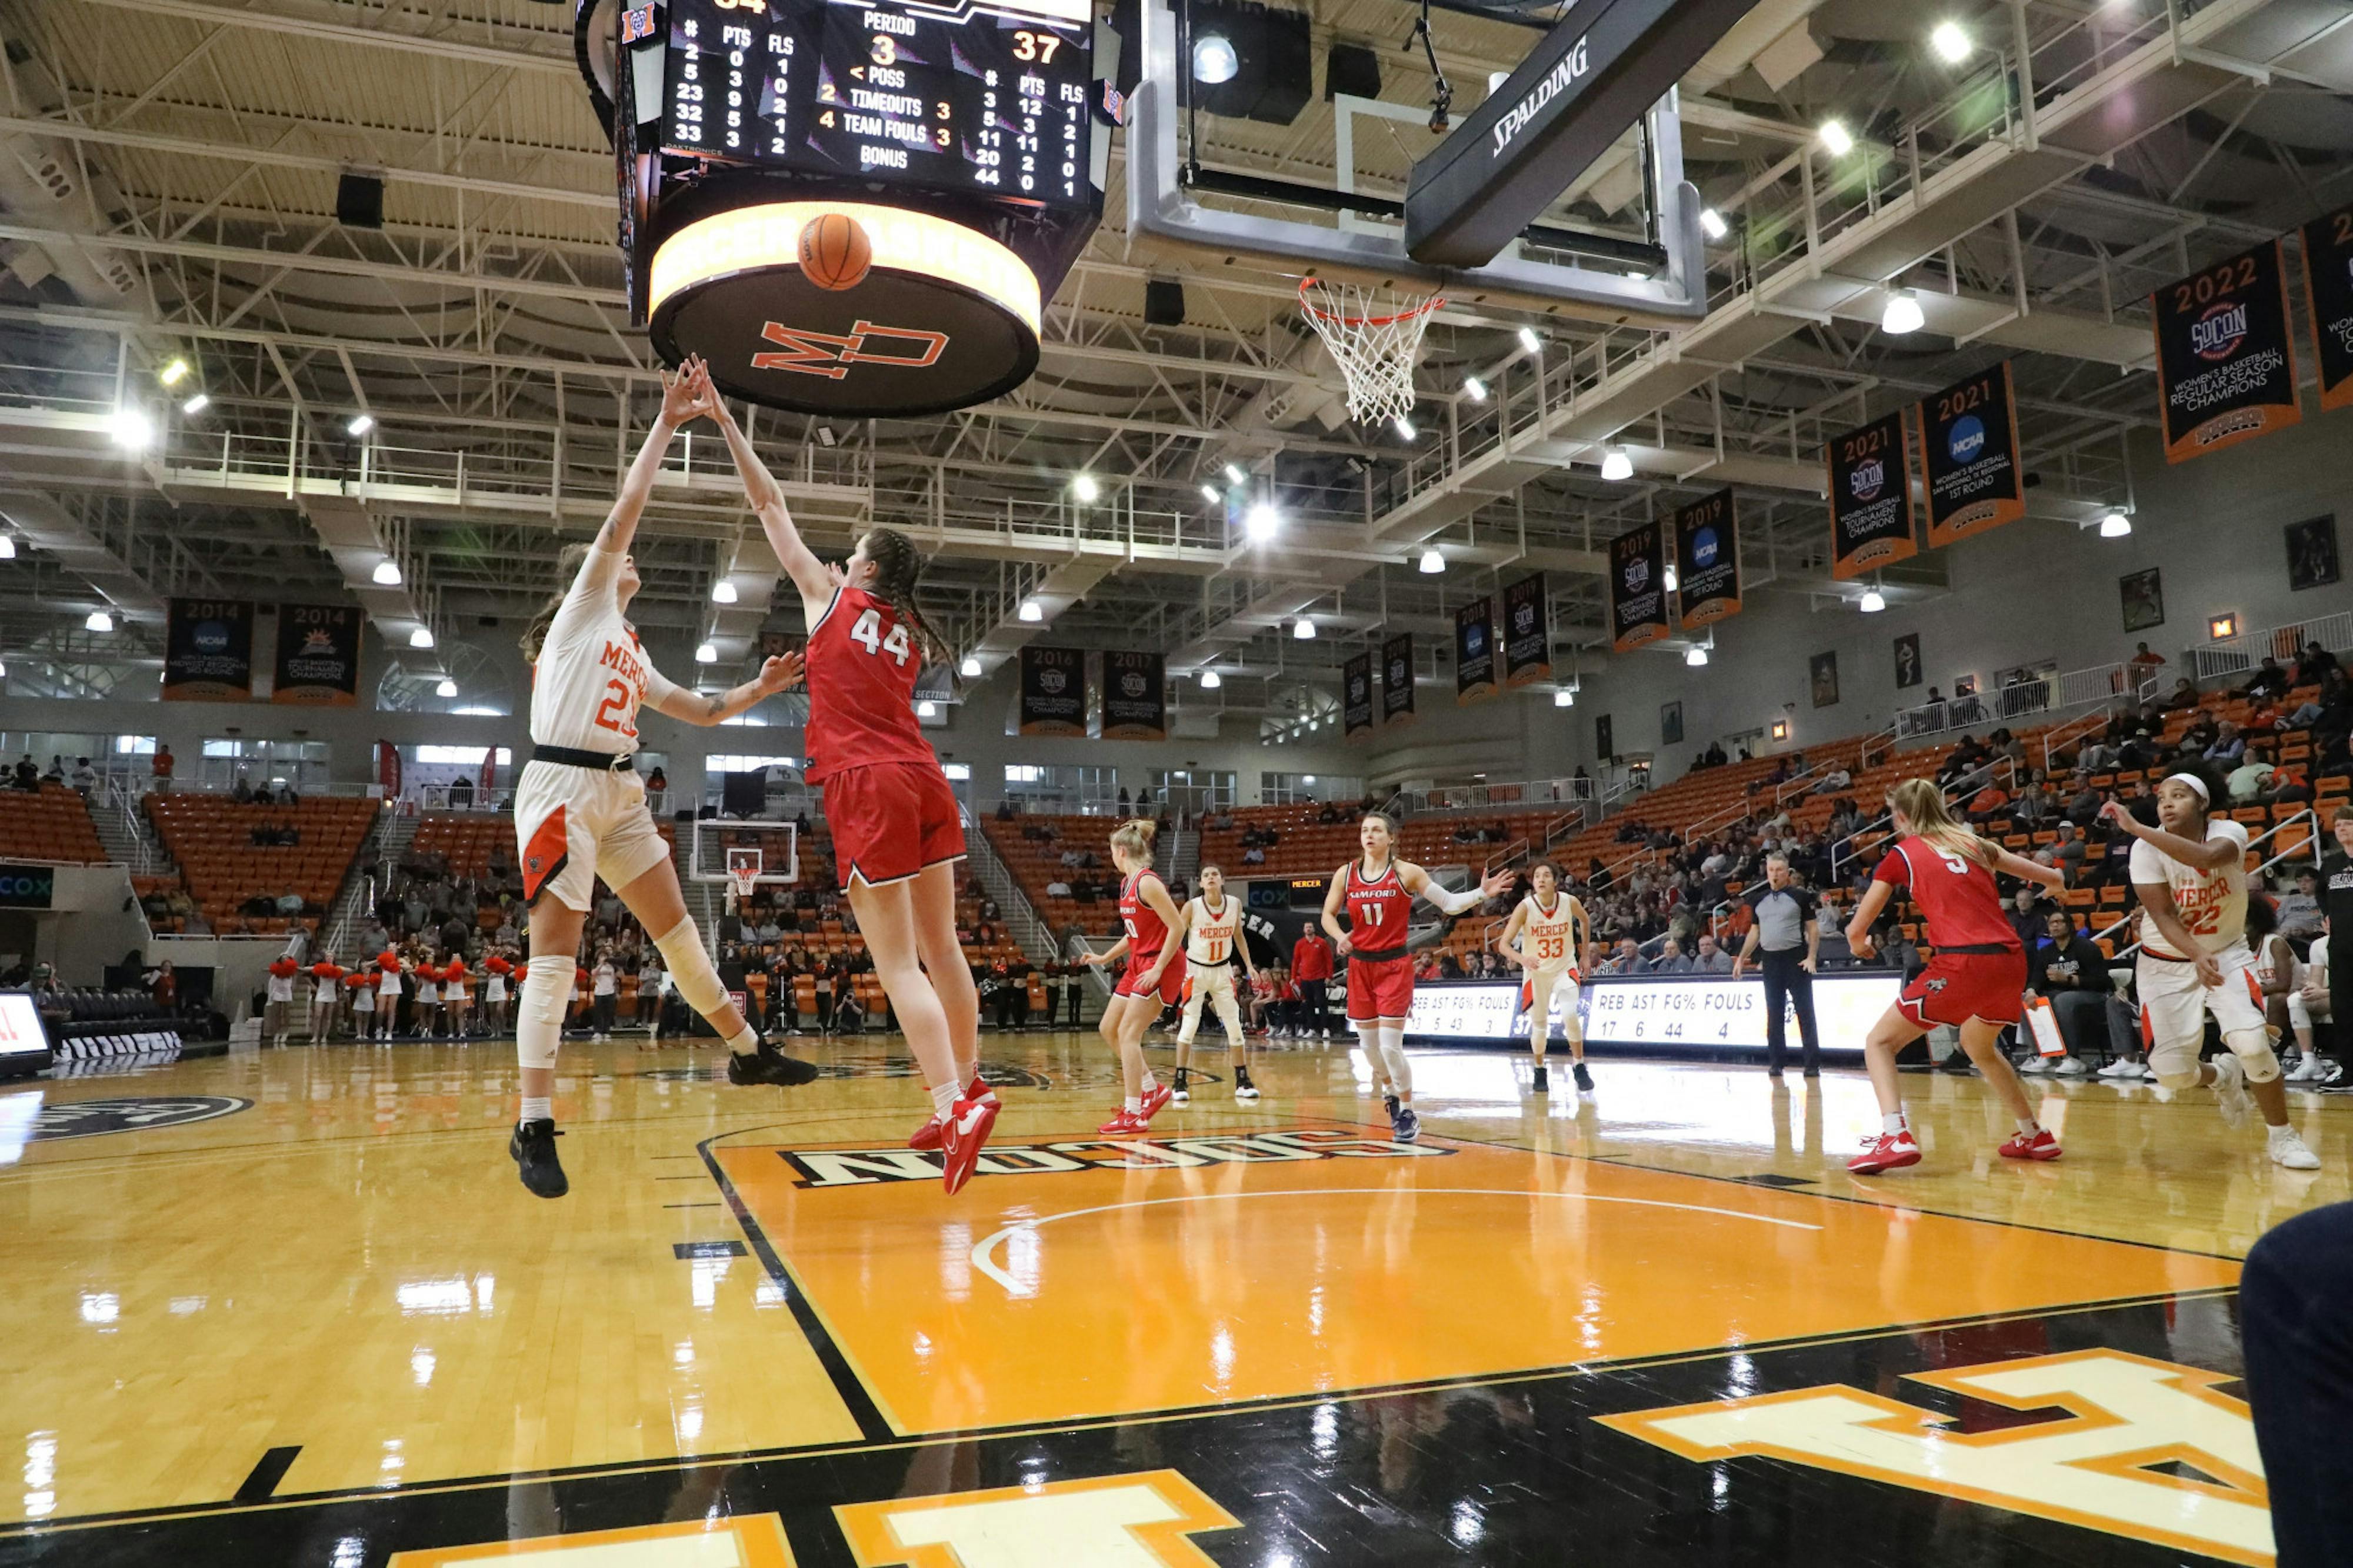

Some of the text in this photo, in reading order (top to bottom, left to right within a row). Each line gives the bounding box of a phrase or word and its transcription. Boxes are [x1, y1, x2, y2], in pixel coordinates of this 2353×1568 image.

[864, 10, 916, 36] PERIOD
[723, 25, 751, 47] PTS
[768, 34, 794, 55] FLS
[871, 34, 896, 66] 3
[1012, 31, 1059, 64] 37
[685, 44, 788, 74] 2 0 1
[684, 63, 788, 94] 5 3 0
[868, 65, 906, 89] POSS
[1019, 75, 1045, 96] PTS
[1061, 83, 1083, 104] FLS
[676, 83, 787, 115] 23 9 2
[821, 84, 951, 120] 2 TIMEOUTS 3
[984, 92, 1076, 121] 3 12 1
[1493, 35, 1590, 159] SPALDING
[676, 102, 786, 134] 32 5 1
[819, 111, 951, 146] 4 TEAM FOULS 3
[983, 111, 1076, 141] 5 3 2
[675, 123, 785, 155] 33 3 2
[979, 129, 1075, 159] 11 11 1
[860, 145, 908, 169] BONUS
[976, 148, 1075, 178] 20 2 0
[975, 168, 1074, 196] 44 0 1
[2177, 258, 2258, 313] 2022
[2170, 354, 2283, 406] REGULAR SEASON
[2175, 368, 2220, 392] WOMEN'S
[2221, 347, 2278, 376] BASKETBALL
[1938, 379, 1990, 422] 2021
[2187, 373, 2268, 412] CHAMPIONS
[1845, 426, 1889, 462] 2021
[1953, 432, 1984, 456] NCAA
[1968, 453, 2005, 473] BASKETBALL
[1949, 475, 1994, 499] 1ST ROUND
[1686, 500, 1721, 531] 2019
[1846, 504, 1897, 529] TOURNAMENT
[1849, 516, 1895, 538] CHAMPIONS
[1620, 531, 1651, 559] 2019
[186, 603, 238, 619] 2014
[294, 608, 345, 625] 2014
[850, 608, 910, 667] 44
[1034, 650, 1073, 666] 2016
[915, 690, 951, 699] SECTION
[0, 876, 51, 895] COX
[1250, 890, 1288, 905] COX
[1292, 880, 1321, 888] MERCER
[1349, 889, 1397, 899] SAMFORD
[1361, 902, 1383, 926] 11
[1199, 926, 1234, 939] MERCER
[1531, 922, 1569, 937] MERCER
[1209, 941, 1223, 961] 11
[1538, 937, 1564, 959] 33
[1432, 997, 1449, 1009] AST
[1453, 997, 1473, 1009] FG%
[1479, 996, 1509, 1009] FOULS
[1599, 995, 1624, 1010] REB
[1632, 994, 1657, 1010] AST
[1664, 994, 1695, 1010] FG%
[1704, 993, 1752, 1010] FOULS
[1434, 1017, 1441, 1030] 5
[1450, 1018, 1462, 1030] 43
[1486, 1020, 1492, 1033] 3
[1602, 1021, 1728, 1039] 17 6 44 4
